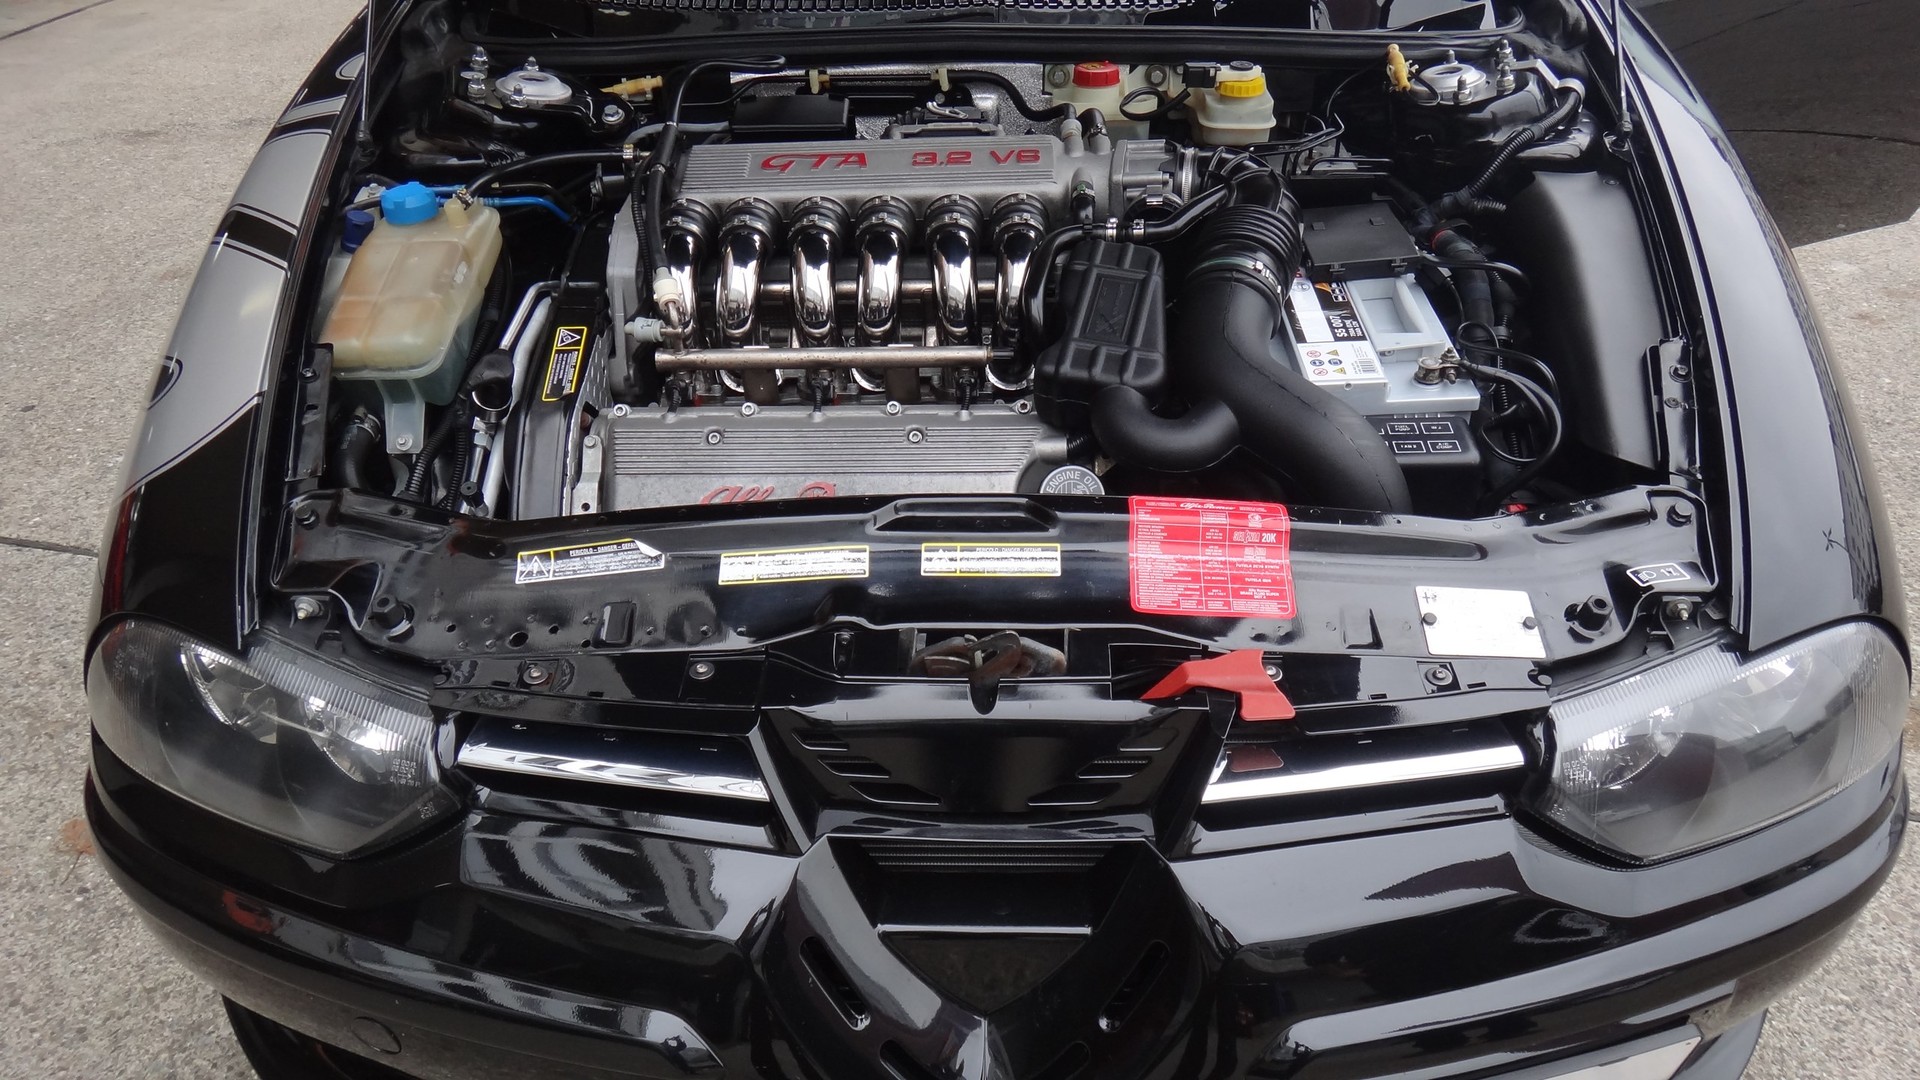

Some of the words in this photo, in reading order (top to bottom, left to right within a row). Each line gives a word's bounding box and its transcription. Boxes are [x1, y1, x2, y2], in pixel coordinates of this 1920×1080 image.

[760, 152, 868, 175] GTA
[911, 151, 972, 167] 3.2
[989, 149, 1041, 165] V6
[1330, 315, 1343, 328] 007
[1046, 470, 1081, 493] ENGINE
[1083, 476, 1098, 492] OIL
[1262, 533, 1277, 543] 20K
